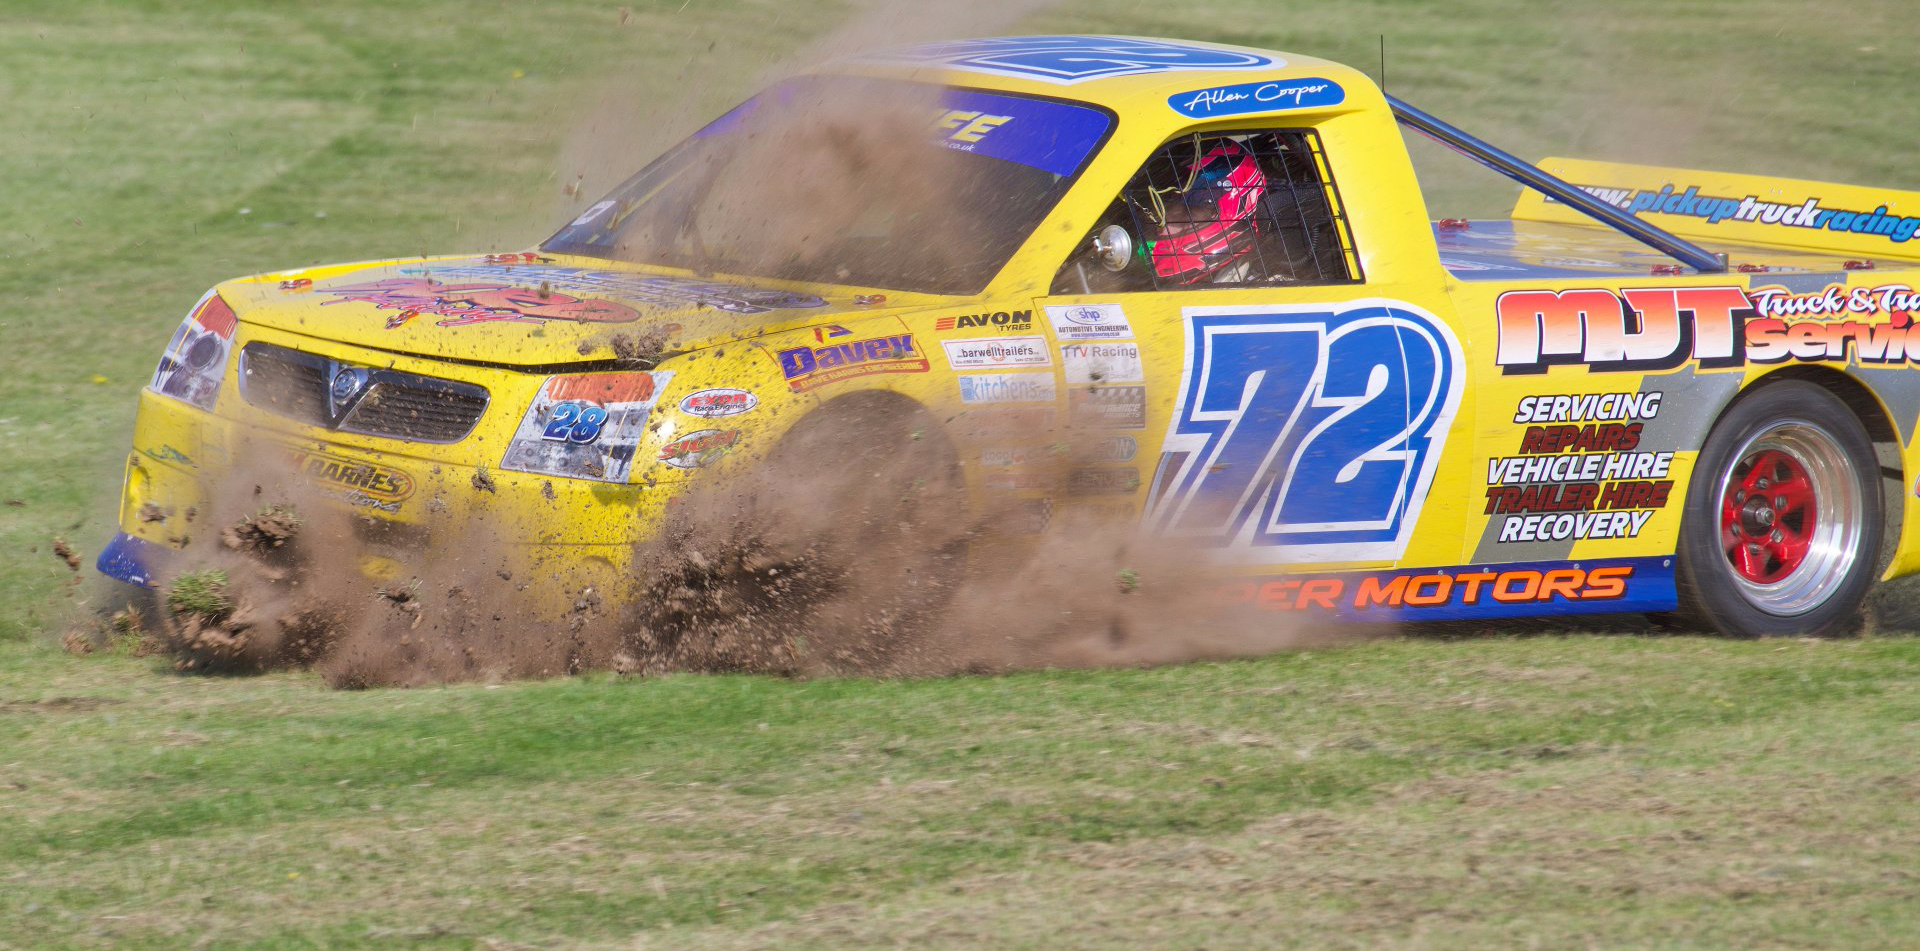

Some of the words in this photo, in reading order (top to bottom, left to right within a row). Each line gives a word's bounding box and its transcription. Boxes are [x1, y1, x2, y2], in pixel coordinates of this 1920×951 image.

[1184, 90, 1249, 111] Allen
[1255, 83, 1328, 105] Cooper
[1079, 307, 1101, 322] shp
[1750, 286, 1846, 318] Truck
[1847, 286, 1879, 315] &
[956, 310, 1033, 329] AVON
[999, 323, 1032, 332] TYRES
[1058, 326, 1093, 334] AUTOMOTIVE
[1094, 324, 1129, 332] ENGINEERING
[1496, 287, 1755, 376] MJT
[1061, 344, 1089, 358] TTV
[1091, 345, 1137, 359] Racing
[1513, 391, 1663, 423] SERVICING
[541, 402, 610, 445] 28
[1144, 299, 1465, 560] 72
[1518, 423, 1644, 454] REPAIRS
[1486, 453, 1602, 485] VEHICLE
[1600, 450, 1675, 480] HIRE
[1483, 482, 1600, 515] TRAILER
[1596, 480, 1675, 511] HIRE
[1497, 509, 1656, 544] RECOVERY
[1353, 566, 1634, 608] MOTORS
